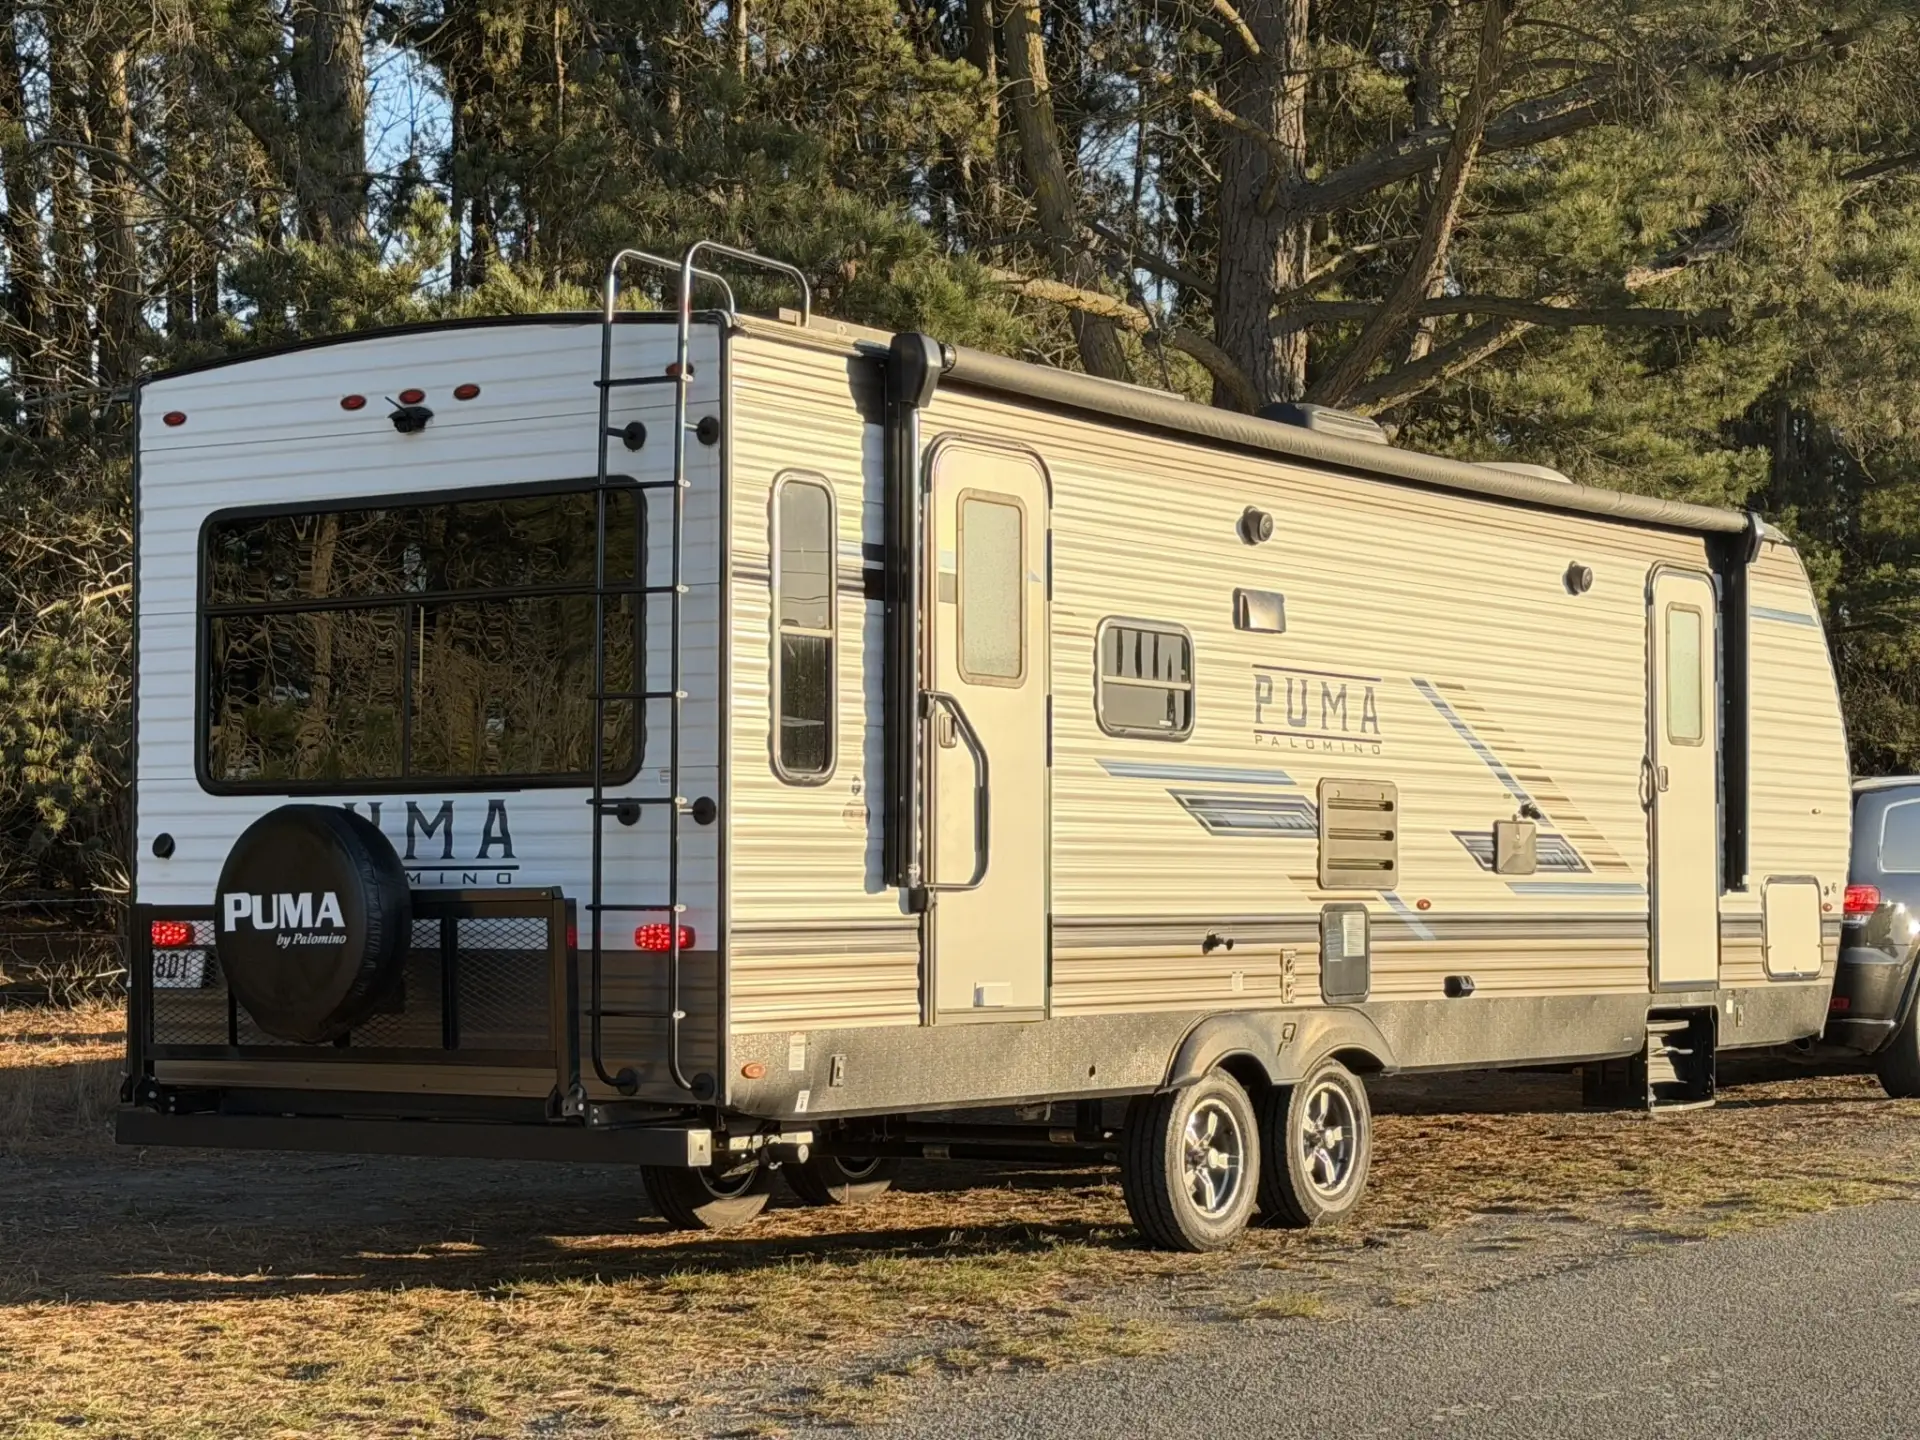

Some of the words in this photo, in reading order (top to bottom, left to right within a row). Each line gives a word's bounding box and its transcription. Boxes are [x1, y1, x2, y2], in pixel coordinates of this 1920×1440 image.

[1253, 674, 1381, 734] PUMA
[1254, 735, 1381, 755] PALOMINO
[342, 799, 517, 860] MA
[404, 872, 512, 885] MINO
[223, 892, 346, 932] PUMA
[276, 933, 291, 949] by
[292, 932, 347, 945] Palomino
